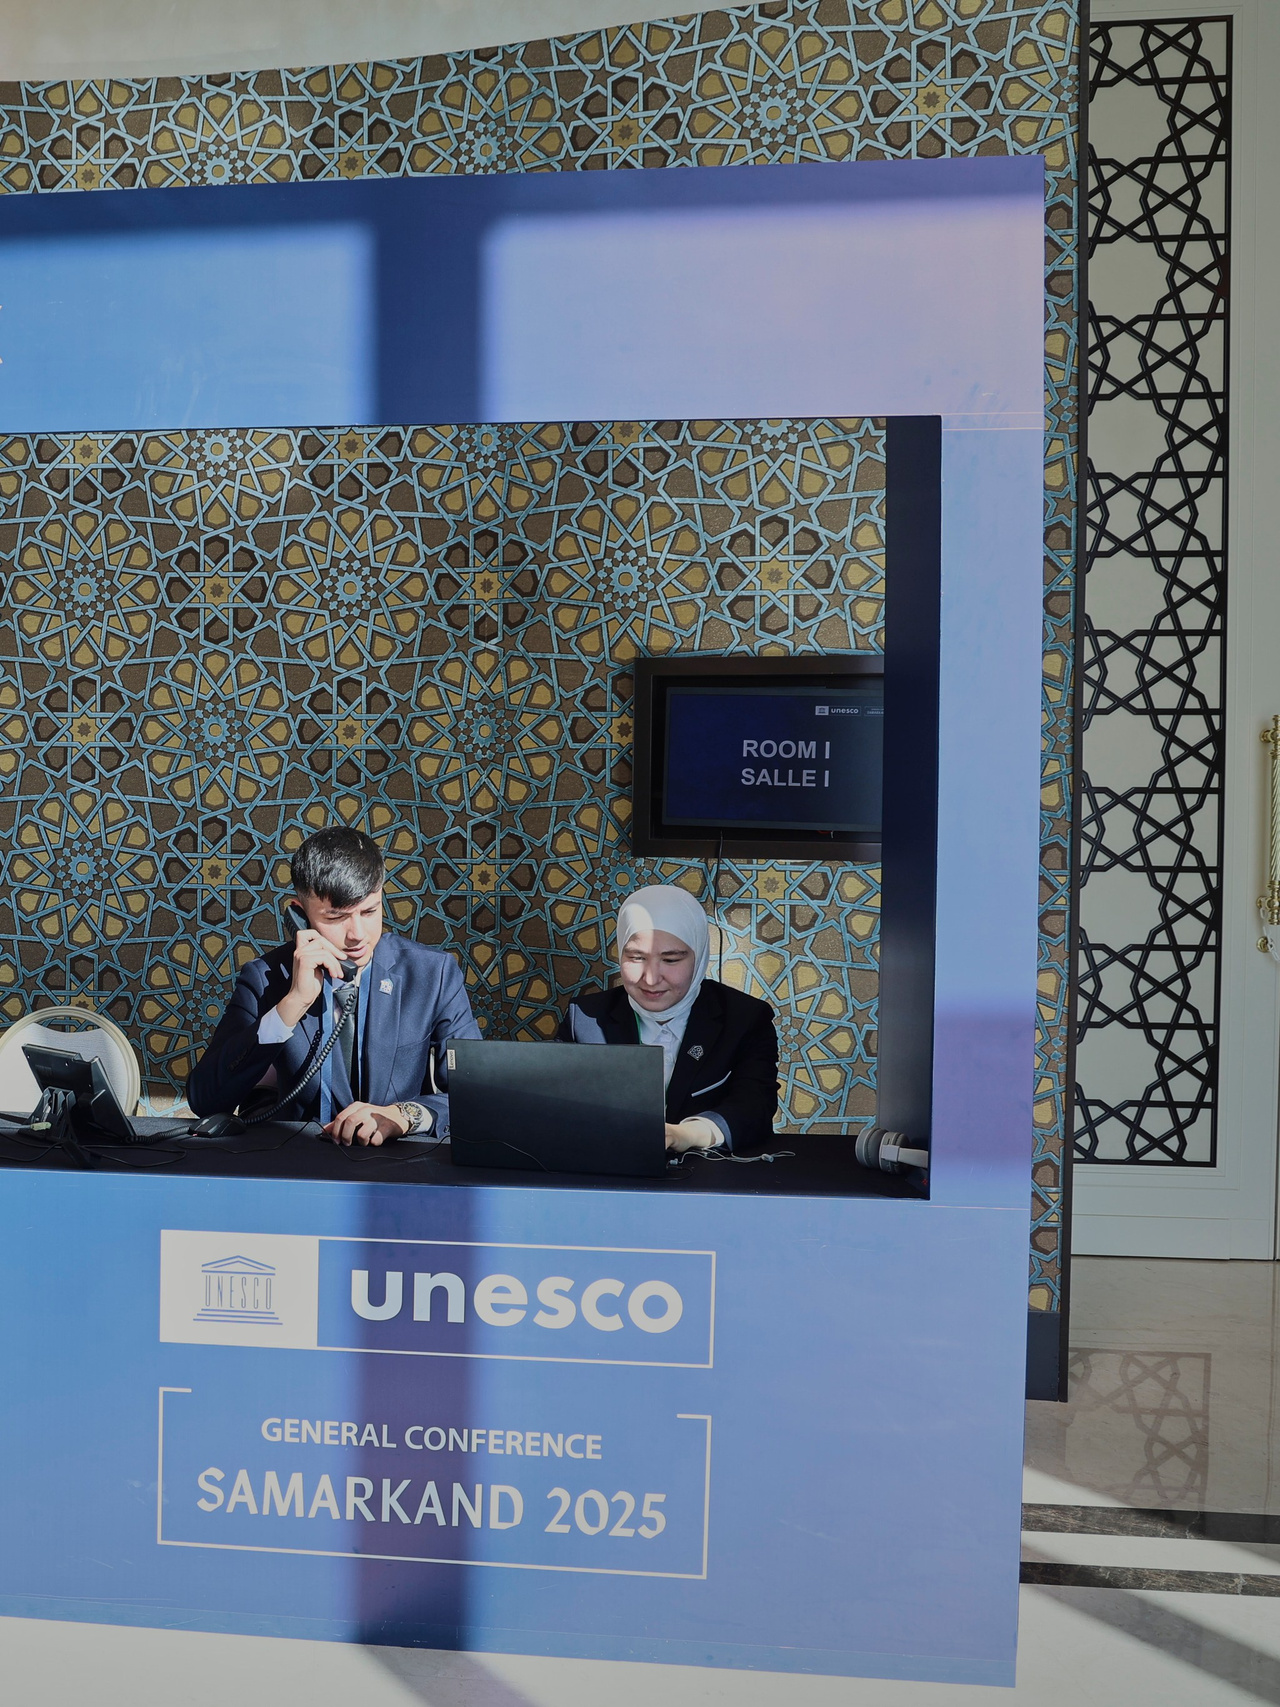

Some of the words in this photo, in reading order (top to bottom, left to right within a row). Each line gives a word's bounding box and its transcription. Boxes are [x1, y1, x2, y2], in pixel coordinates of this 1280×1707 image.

[742, 739, 817, 759] ROOM
[741, 768, 817, 787] SALLE
[205, 1274, 272, 1310] UNESCO
[350, 1268, 684, 1334] unesco
[261, 1417, 397, 1449] GENERAL
[404, 1425, 603, 1460] CONFERENCE
[196, 1466, 524, 1530] SAMARKAND
[544, 1487, 667, 1540] 2025
